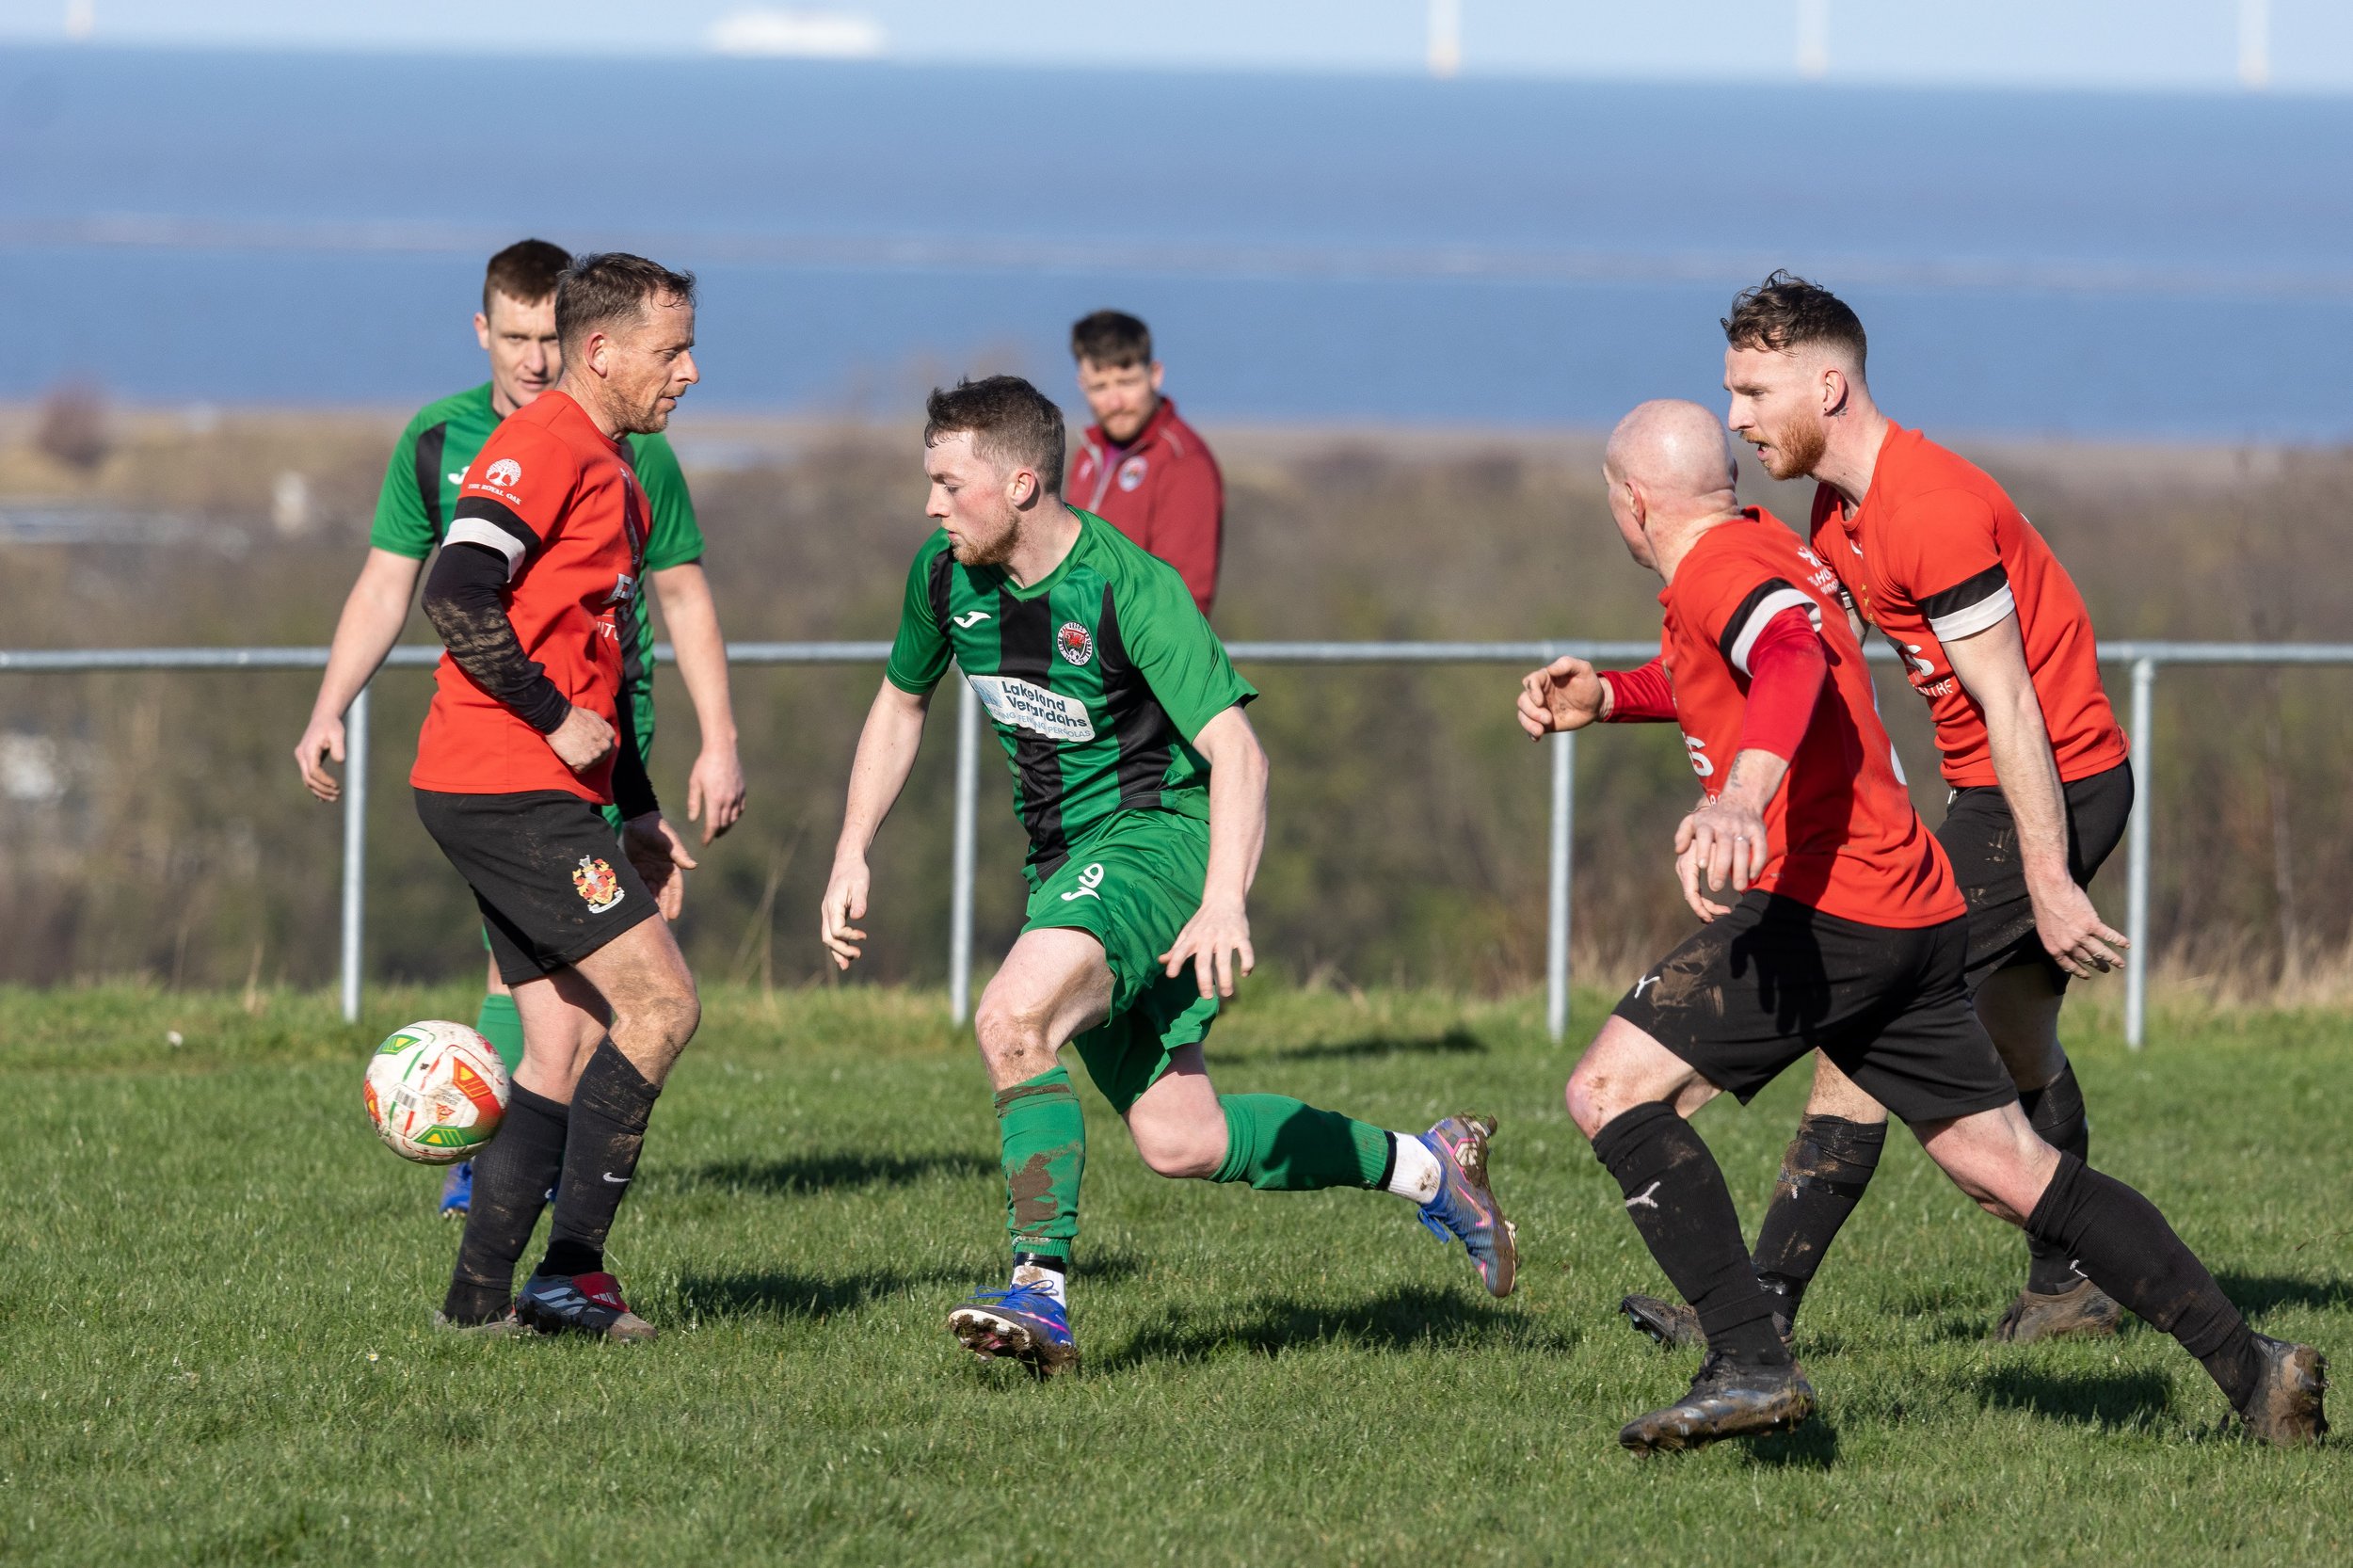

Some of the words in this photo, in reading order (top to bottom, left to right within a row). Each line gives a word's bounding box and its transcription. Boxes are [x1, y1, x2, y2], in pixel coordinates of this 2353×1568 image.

[481, 484, 504, 496] ROYAL
[505, 492, 521, 505] OAK
[1001, 680, 1066, 712] Lakeland
[1006, 696, 1088, 728] Verandahs
